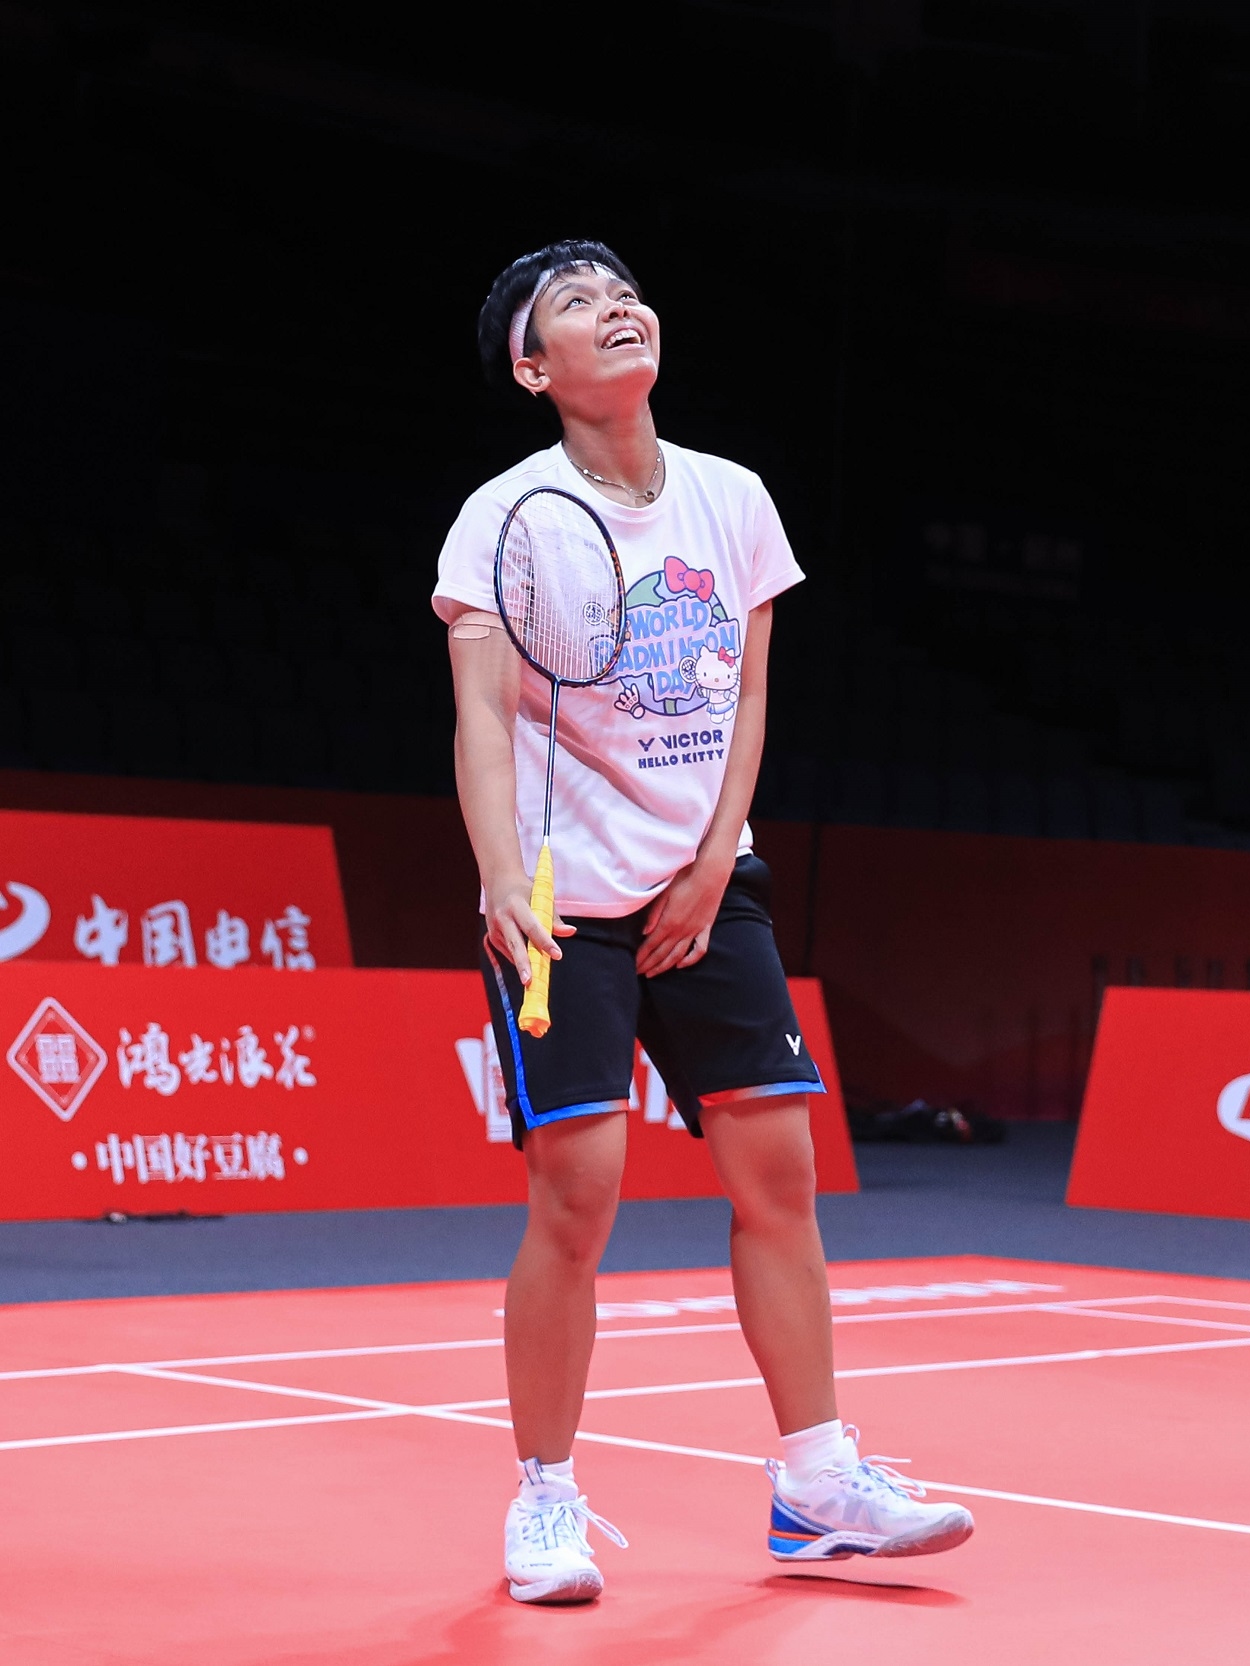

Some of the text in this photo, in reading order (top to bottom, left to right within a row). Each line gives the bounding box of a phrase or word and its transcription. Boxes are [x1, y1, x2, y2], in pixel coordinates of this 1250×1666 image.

[629, 600, 709, 641] WORLD
[659, 729, 724, 750] VICTOR
[638, 749, 724, 769] HELLO KITTY
[73, 894, 317, 971] 中国电信
